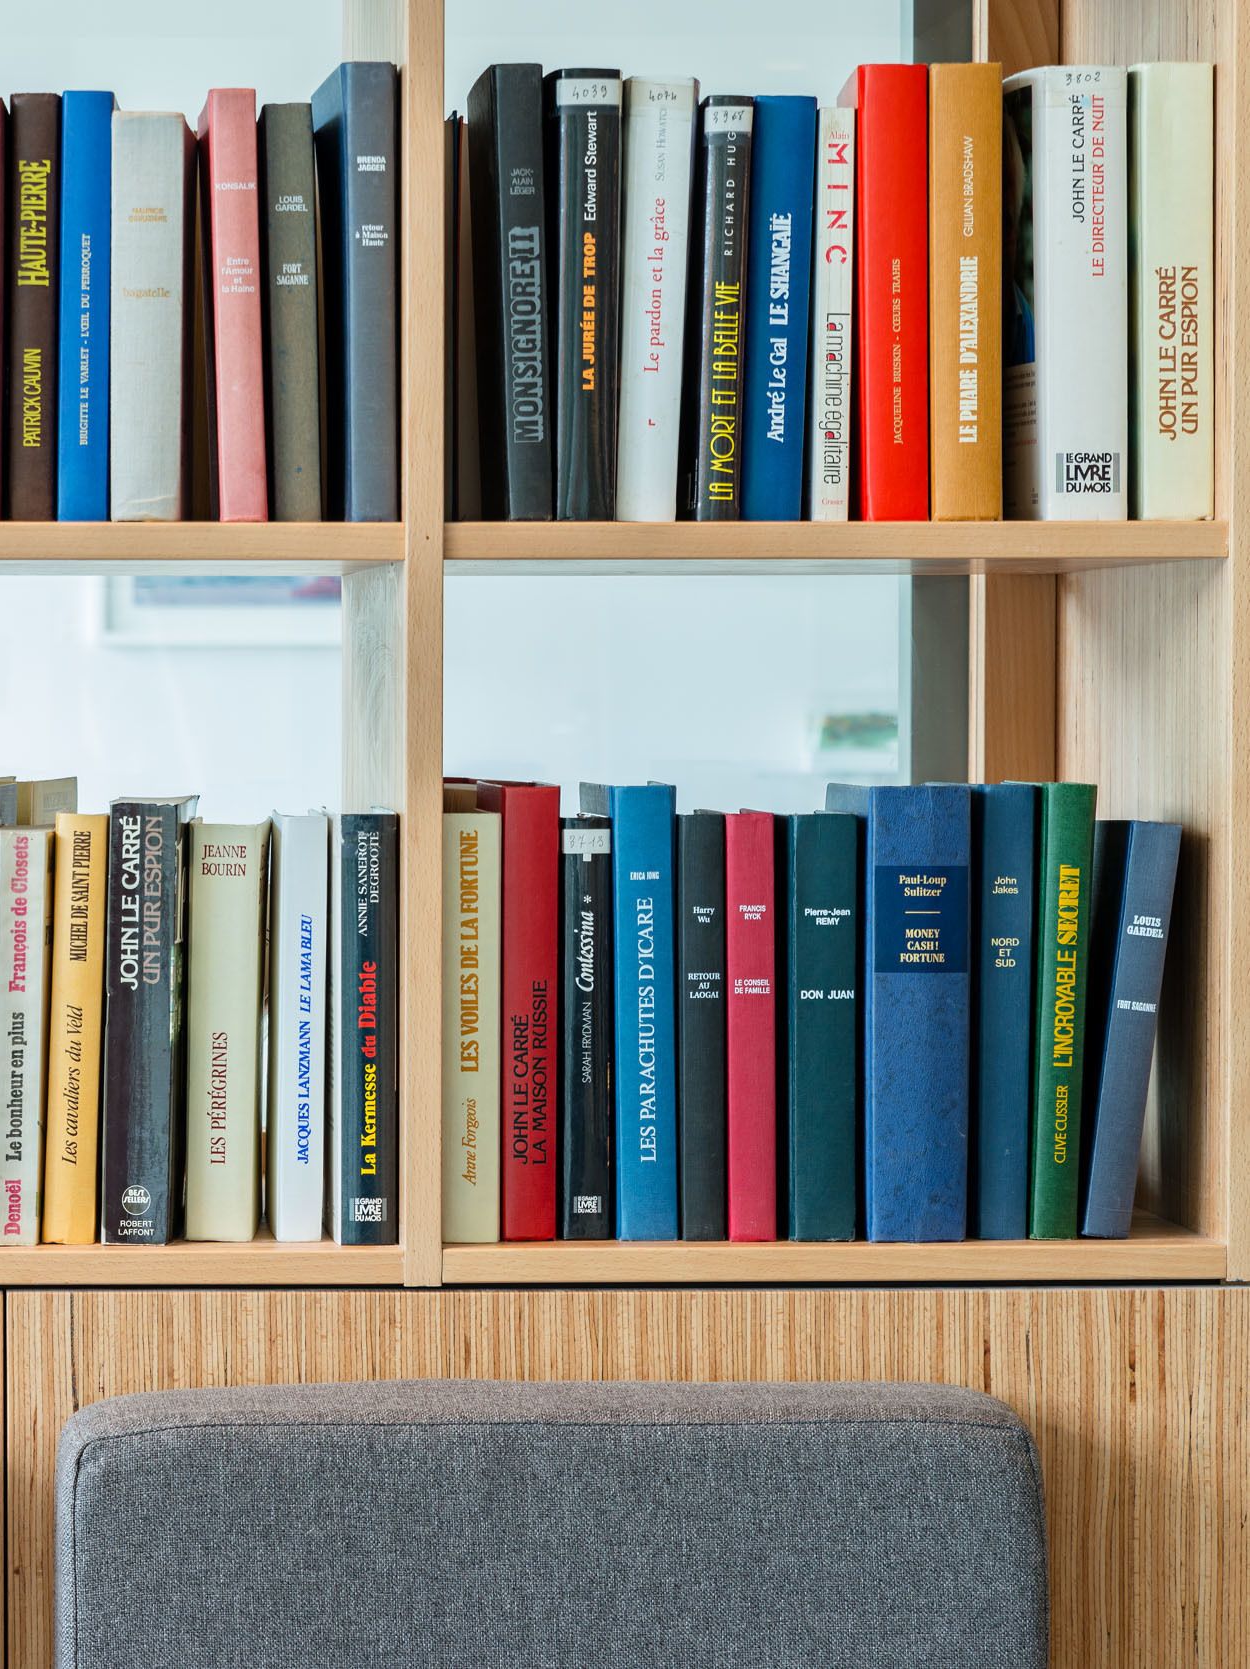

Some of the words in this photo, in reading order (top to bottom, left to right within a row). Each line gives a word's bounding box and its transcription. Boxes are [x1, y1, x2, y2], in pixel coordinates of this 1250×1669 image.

[585, 111, 598, 166] Stewart
[275, 203, 308, 212] GARDEL
[278, 195, 304, 204] LOUIS
[585, 169, 597, 221] Edward
[650, 198, 669, 241] grâce
[509, 226, 540, 261] II
[583, 232, 596, 278] TROP
[648, 246, 663, 261] la
[650, 266, 662, 282] et
[583, 285, 596, 307] DE
[714, 280, 740, 306] VIE
[1155, 266, 1176, 341] CARRÉ
[1181, 265, 1198, 347] ESPION
[646, 289, 667, 346] pardon
[712, 309, 739, 355] BELLE
[509, 261, 543, 442] MONSIGNORE
[580, 309, 595, 365] JURÉE
[23, 349, 41, 395] CAUVIN
[644, 352, 660, 372] Le
[711, 361, 737, 379] LA
[1158, 345, 1177, 373] LE
[1181, 350, 1198, 395] PUR
[582, 368, 595, 390] LA
[711, 387, 736, 404] ET
[23, 397, 41, 447] PATRICK
[1158, 379, 1178, 440] JOHN
[1181, 399, 1198, 435] UN
[710, 413, 736, 473] MORT
[709, 482, 733, 500] LA
[202, 844, 247, 859] JEANNE
[202, 863, 247, 876] BOURIN
[461, 830, 478, 914] FORTUNE
[899, 876, 948, 884] Paul-Loup
[995, 878, 1017, 886] John
[904, 889, 942, 897] Sulitzer
[1057, 865, 1080, 946] SECRET
[461, 917, 478, 940] LA
[804, 909, 851, 917] Pierre-Jean
[574, 910, 596, 992] Contessina
[905, 929, 940, 938] MONEY
[461, 945, 478, 969] DE
[900, 953, 945, 962] FORTUNE
[461, 973, 479, 1035] VOILES
[801, 990, 824, 999] DON
[829, 990, 855, 999] JUAN
[1053, 950, 1077, 1068] L'INCROYABLE
[8, 1012, 26, 1046] plus
[582, 1002, 591, 1049] FRYDMAN
[11, 1049, 23, 1068] en
[461, 1037, 479, 1072] LES
[583, 1051, 591, 1083] SARAH
[639, 985, 656, 1121] PARACHUTES
[207, 1032, 228, 1130] PÉRÉGRINES
[6, 1070, 23, 1138] bonheur
[1056, 1085, 1068, 1131] CUSSLER
[7, 1141, 22, 1161] Le
[210, 1137, 226, 1164] LES
[640, 1126, 657, 1162] LES
[1055, 1133, 1067, 1164] CLIVE
[4, 1179, 22, 1235] Denoël
